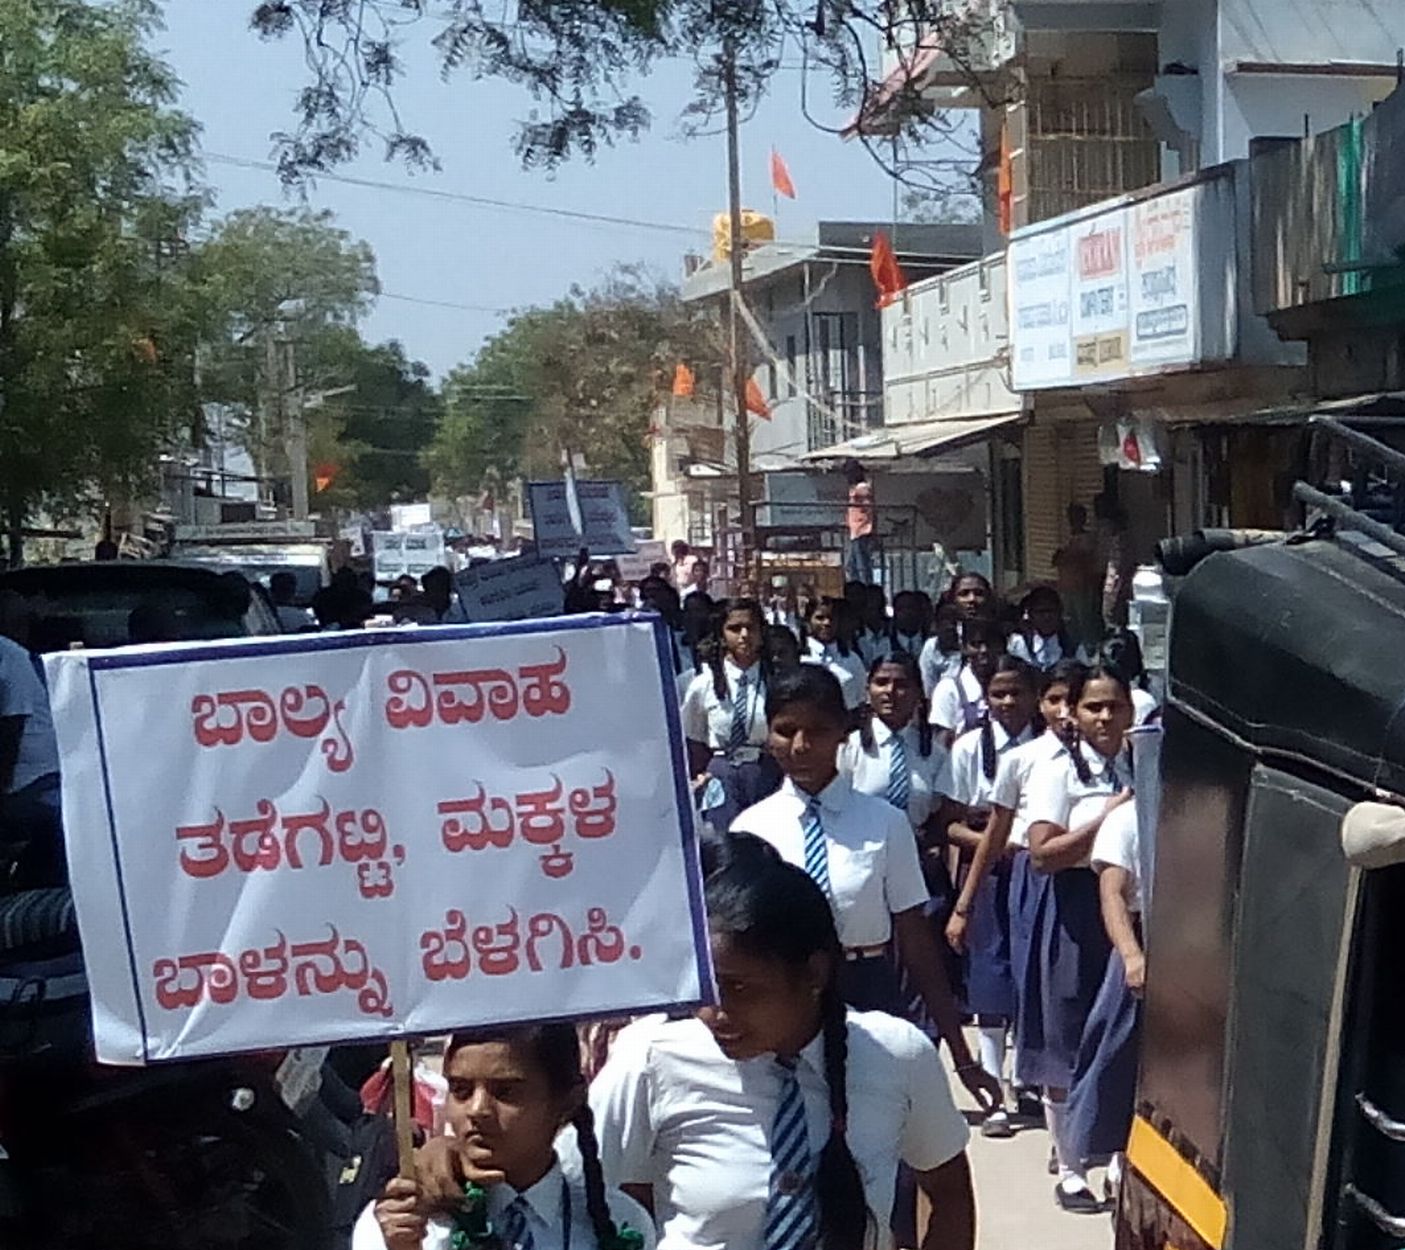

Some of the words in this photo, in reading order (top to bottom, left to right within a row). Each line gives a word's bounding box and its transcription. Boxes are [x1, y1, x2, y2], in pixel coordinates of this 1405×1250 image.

[191, 681, 355, 772] ಬಾಲ್ಯ
[385, 645, 572, 729] ವಿವಾಹ
[438, 767, 617, 879] ಮಕ್ಕಳ
[153, 921, 393, 1015] ಬಾಳನ್ನು
[420, 906, 642, 982] ಬೆಳಗಿಸಿ.
